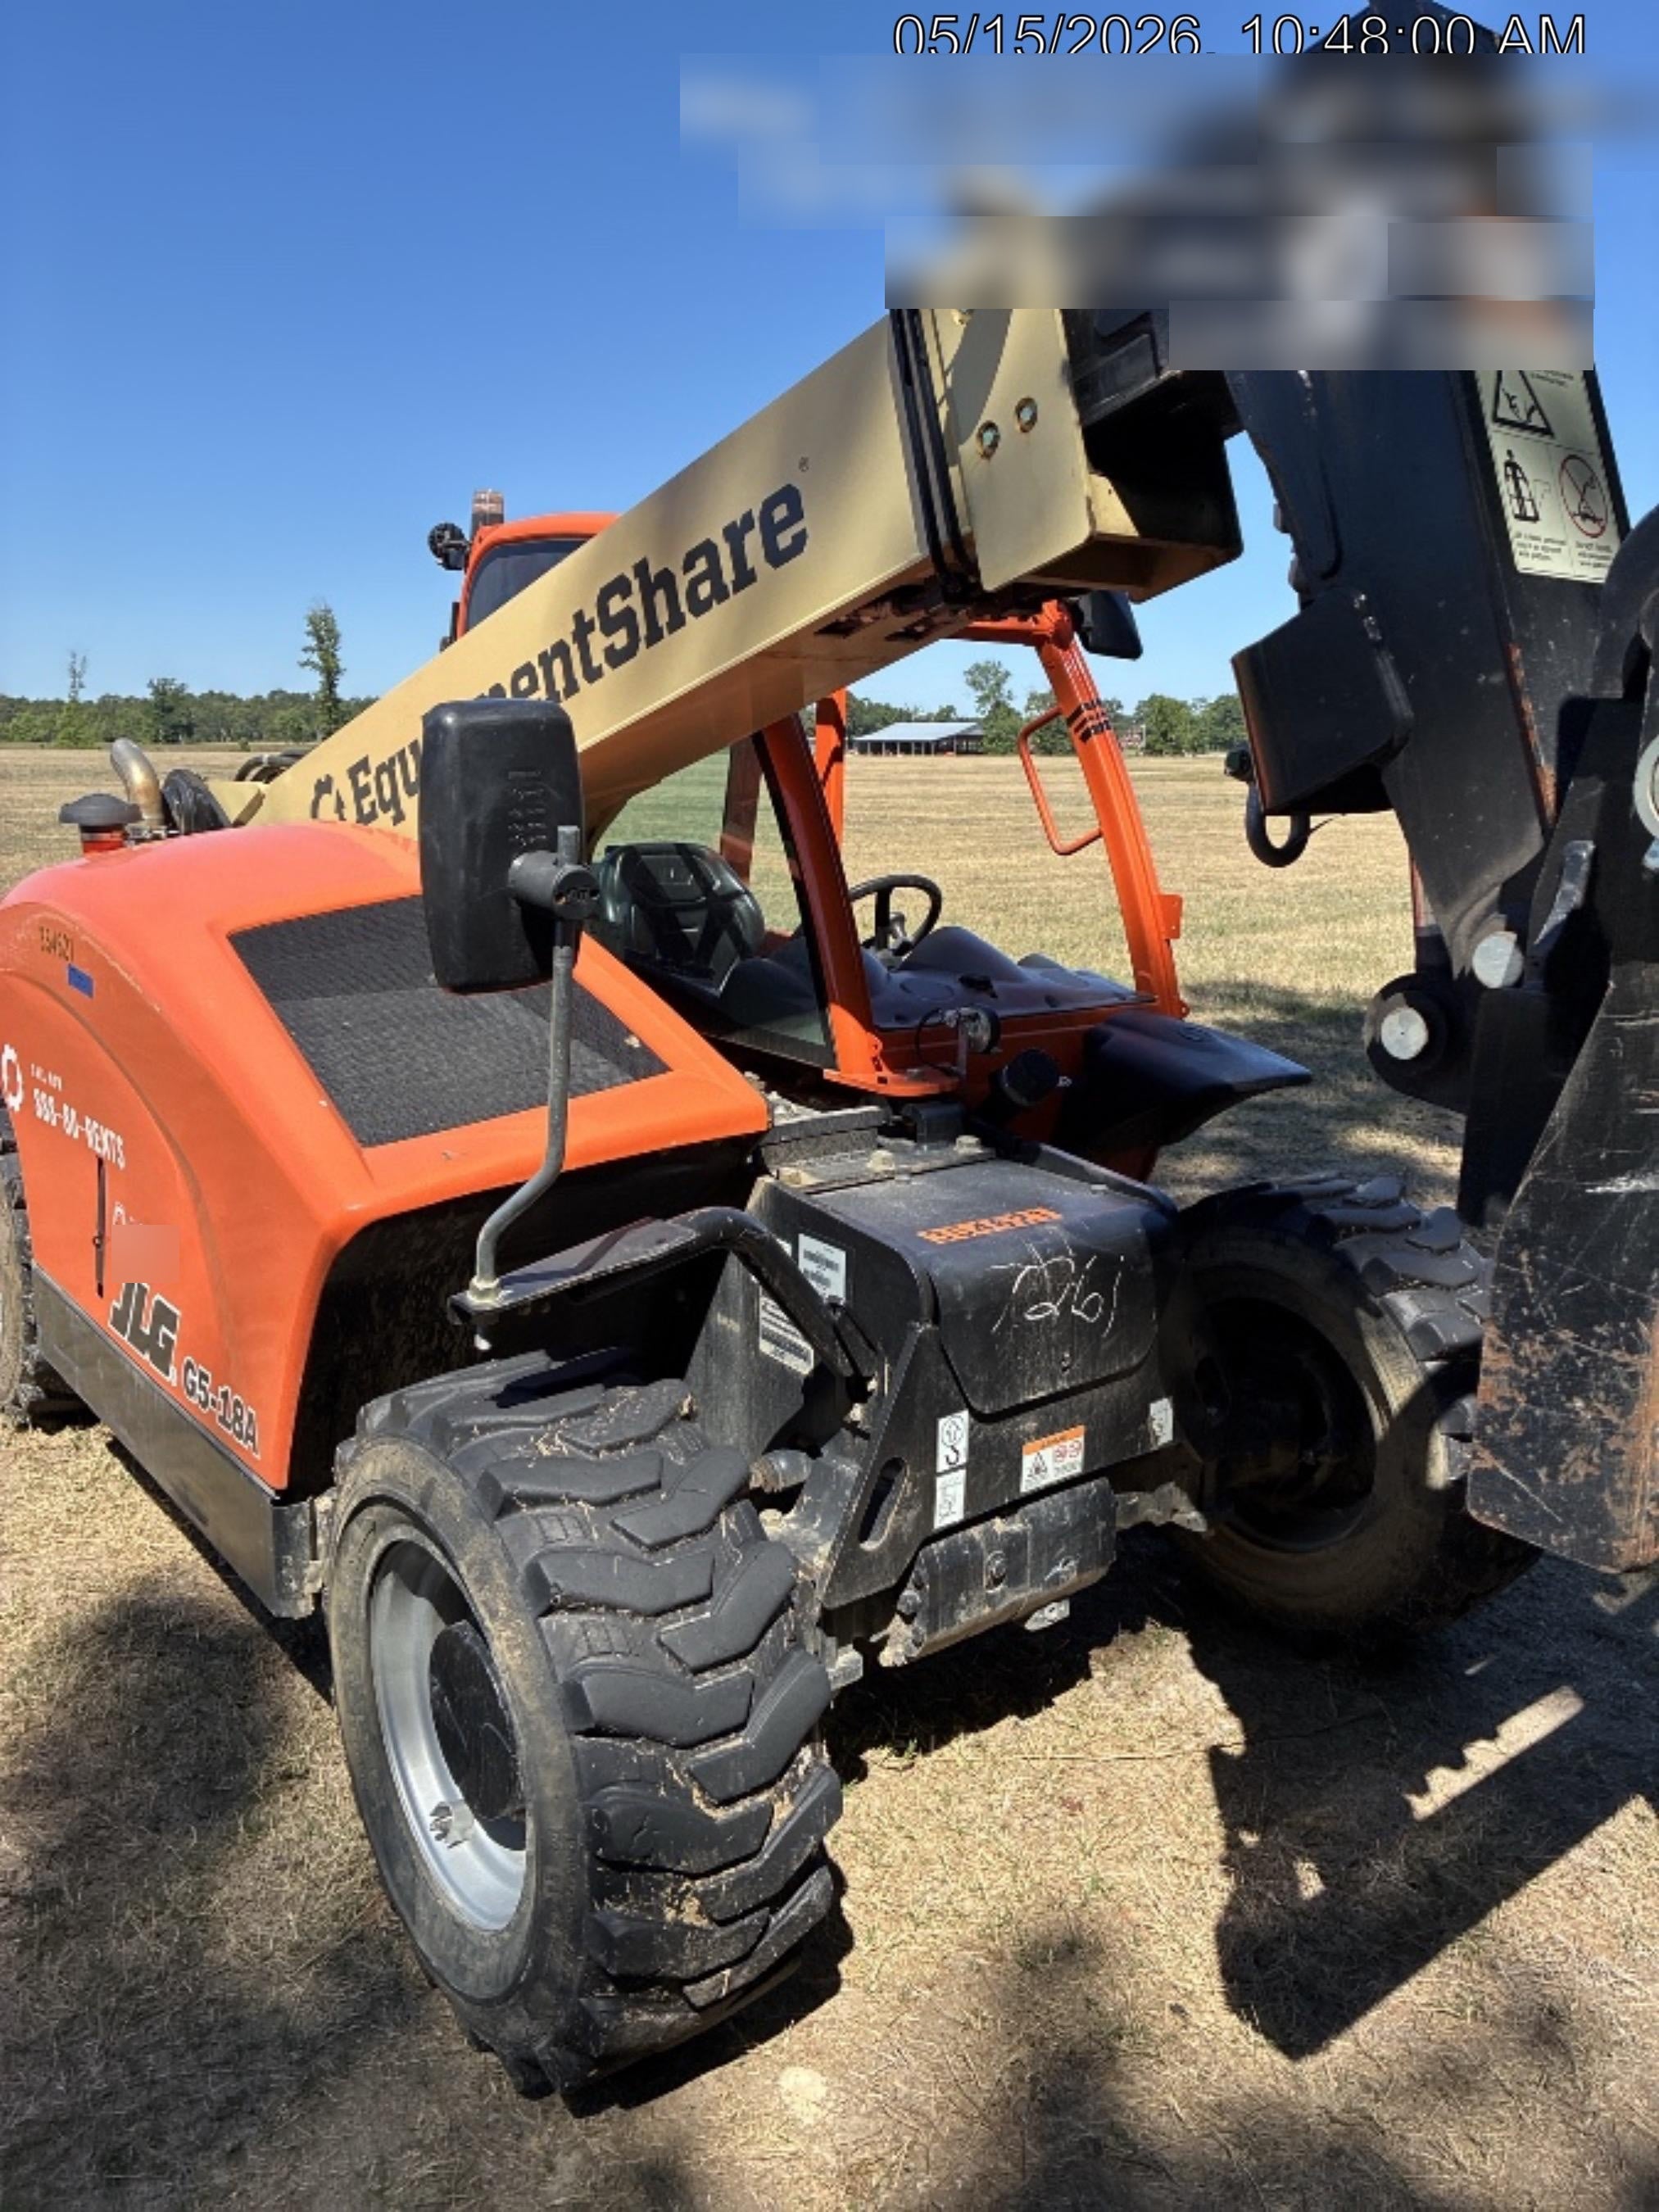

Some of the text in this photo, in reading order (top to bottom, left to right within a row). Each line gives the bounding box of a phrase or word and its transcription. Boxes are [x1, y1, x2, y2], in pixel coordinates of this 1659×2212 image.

[346, 483, 809, 827] EquentShare
[107, 1282, 261, 1460] JLG G5-18A
